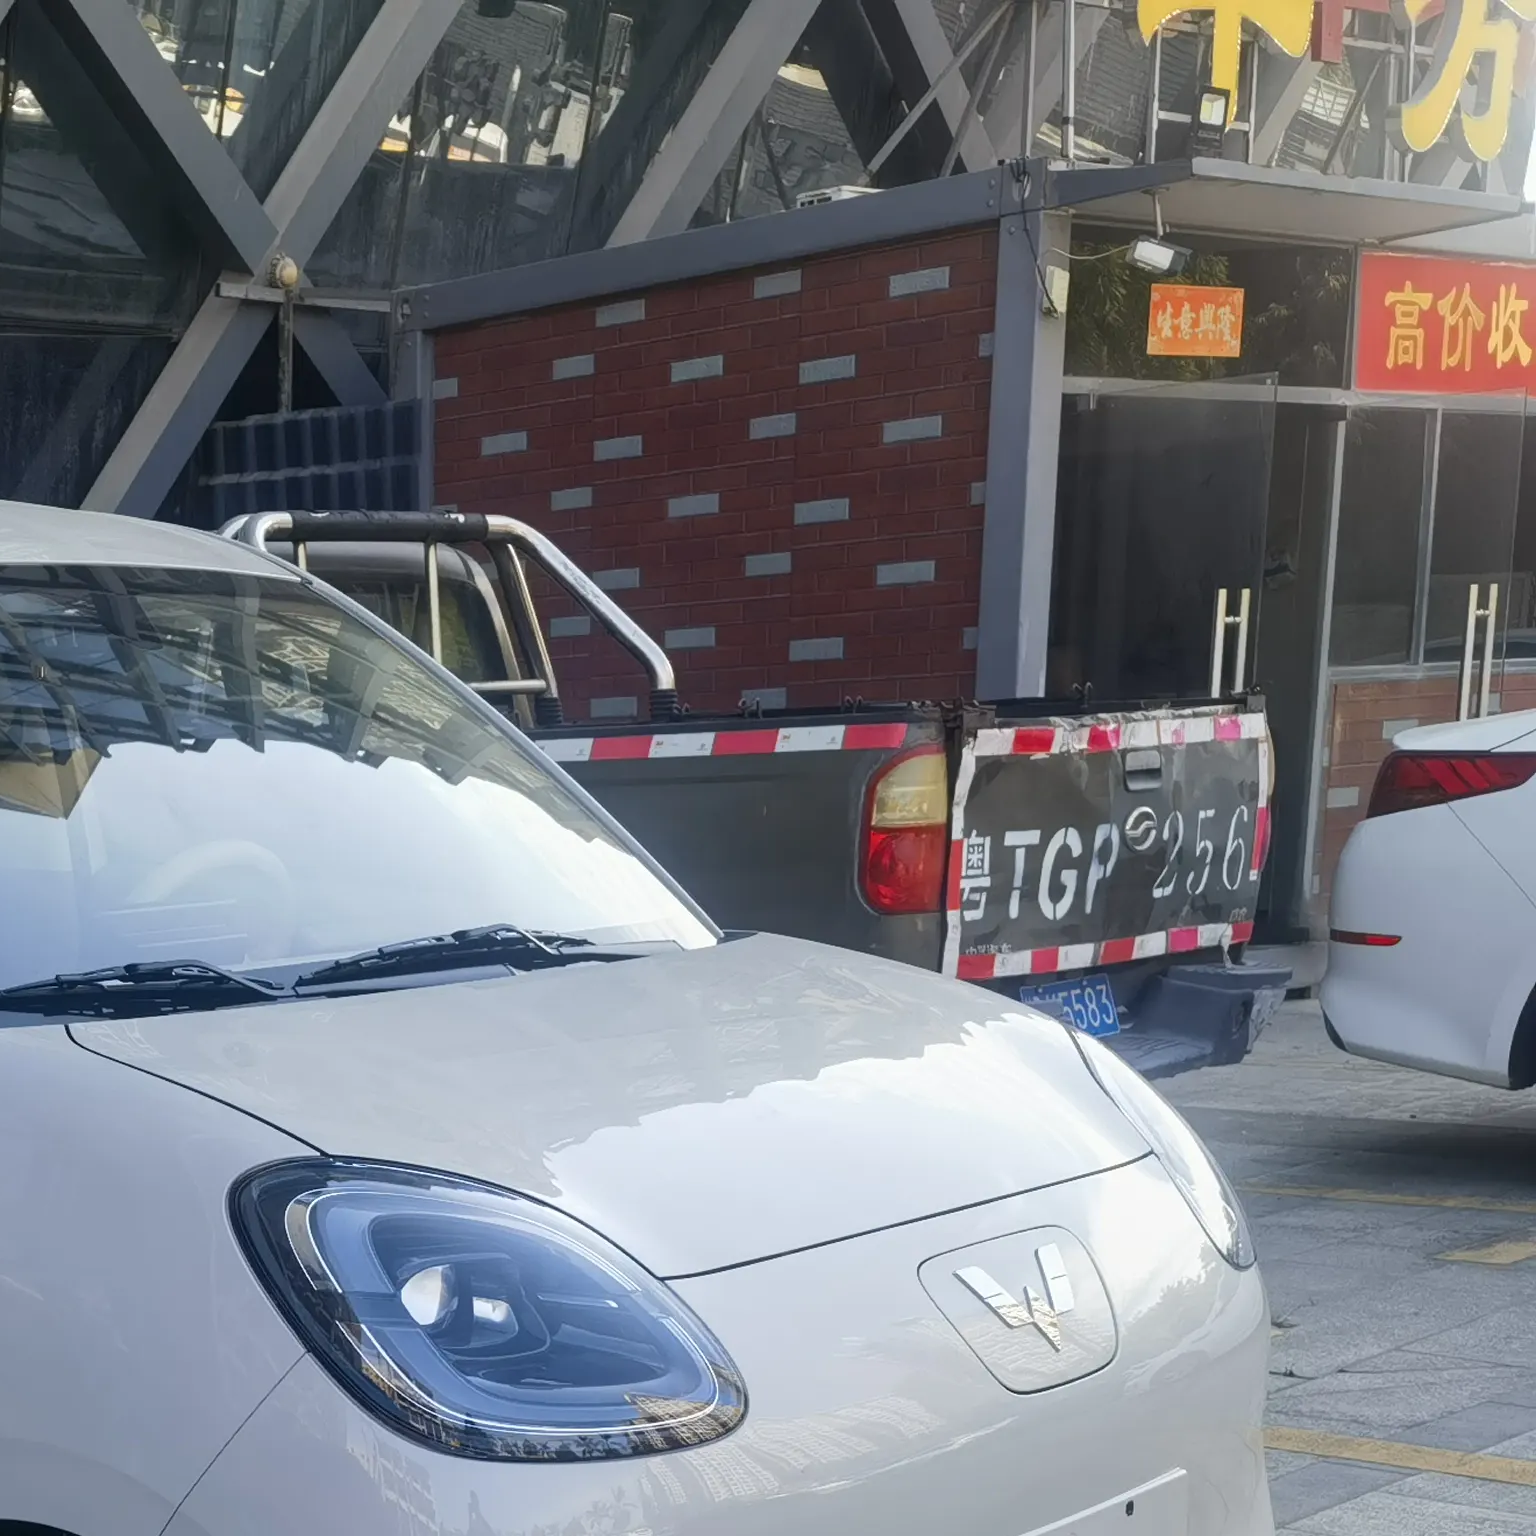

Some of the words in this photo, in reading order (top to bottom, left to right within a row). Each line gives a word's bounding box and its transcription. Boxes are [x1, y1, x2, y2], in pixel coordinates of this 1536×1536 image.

[1384, 280, 1533, 372] 高价收
[959, 822, 1120, 921] 粤TGP
[1152, 805, 1248, 898] 256
